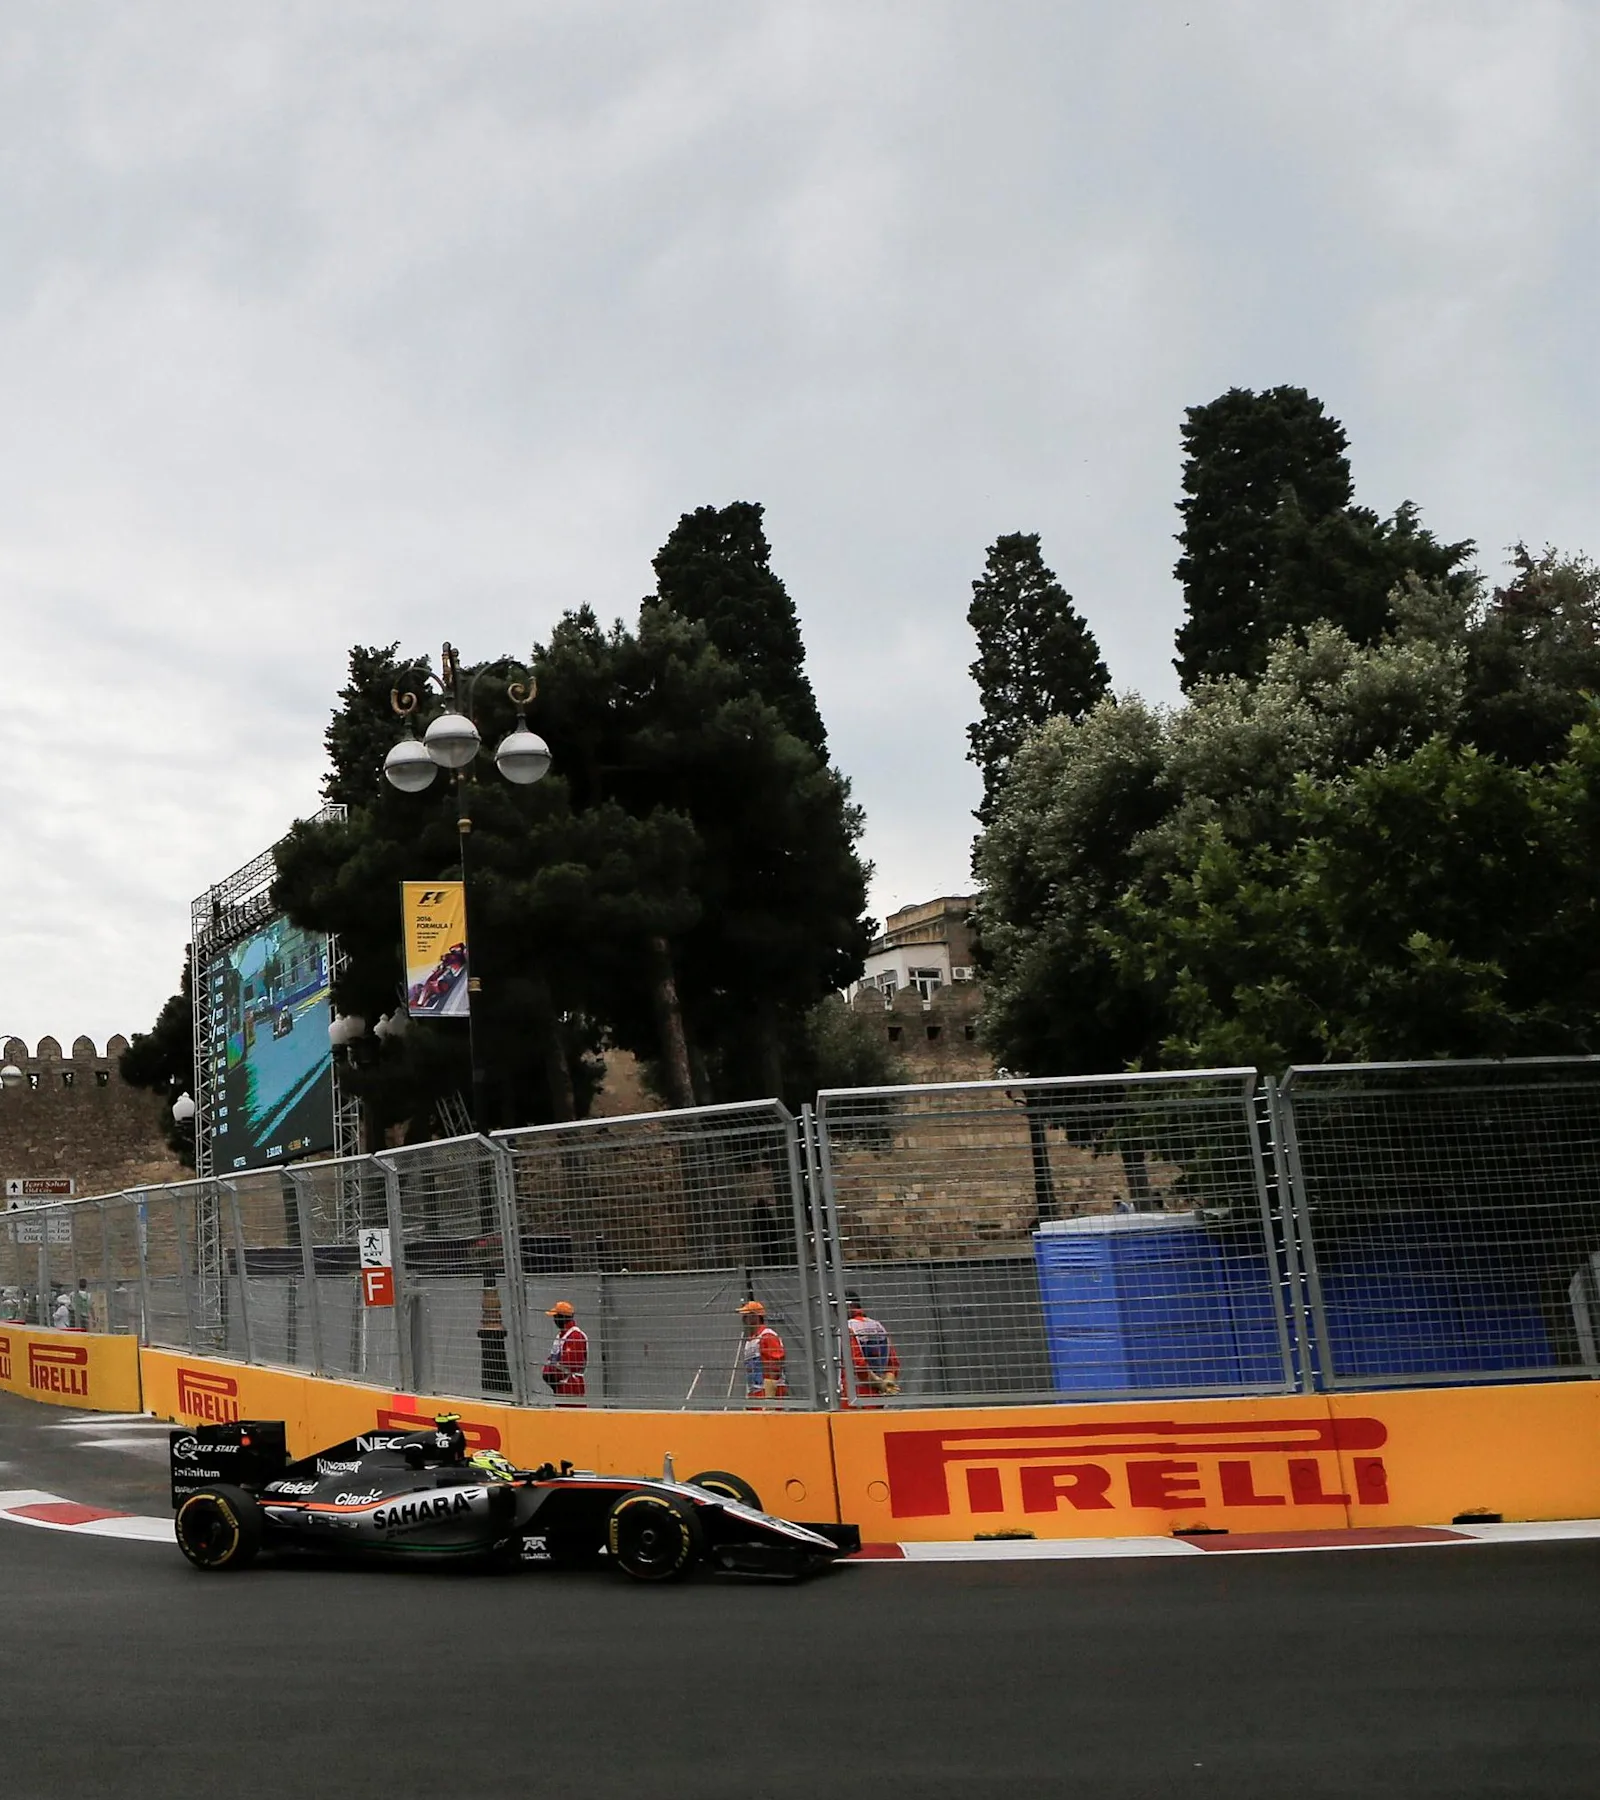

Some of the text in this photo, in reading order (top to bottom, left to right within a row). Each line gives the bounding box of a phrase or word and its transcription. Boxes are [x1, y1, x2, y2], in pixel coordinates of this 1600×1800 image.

[366, 1272, 385, 1301] F
[29, 1343, 88, 1395] PIRELLI
[177, 1368, 238, 1423] PIRELLI
[216, 1444, 240, 1453] STATE
[356, 1436, 405, 1452] NEC
[174, 1466, 220, 1478] infinitum
[884, 1417, 1388, 1518] PIRELLI
[278, 1481, 319, 1495] telcel
[334, 1492, 374, 1506] Claro
[373, 1492, 472, 1530] SAHARA
